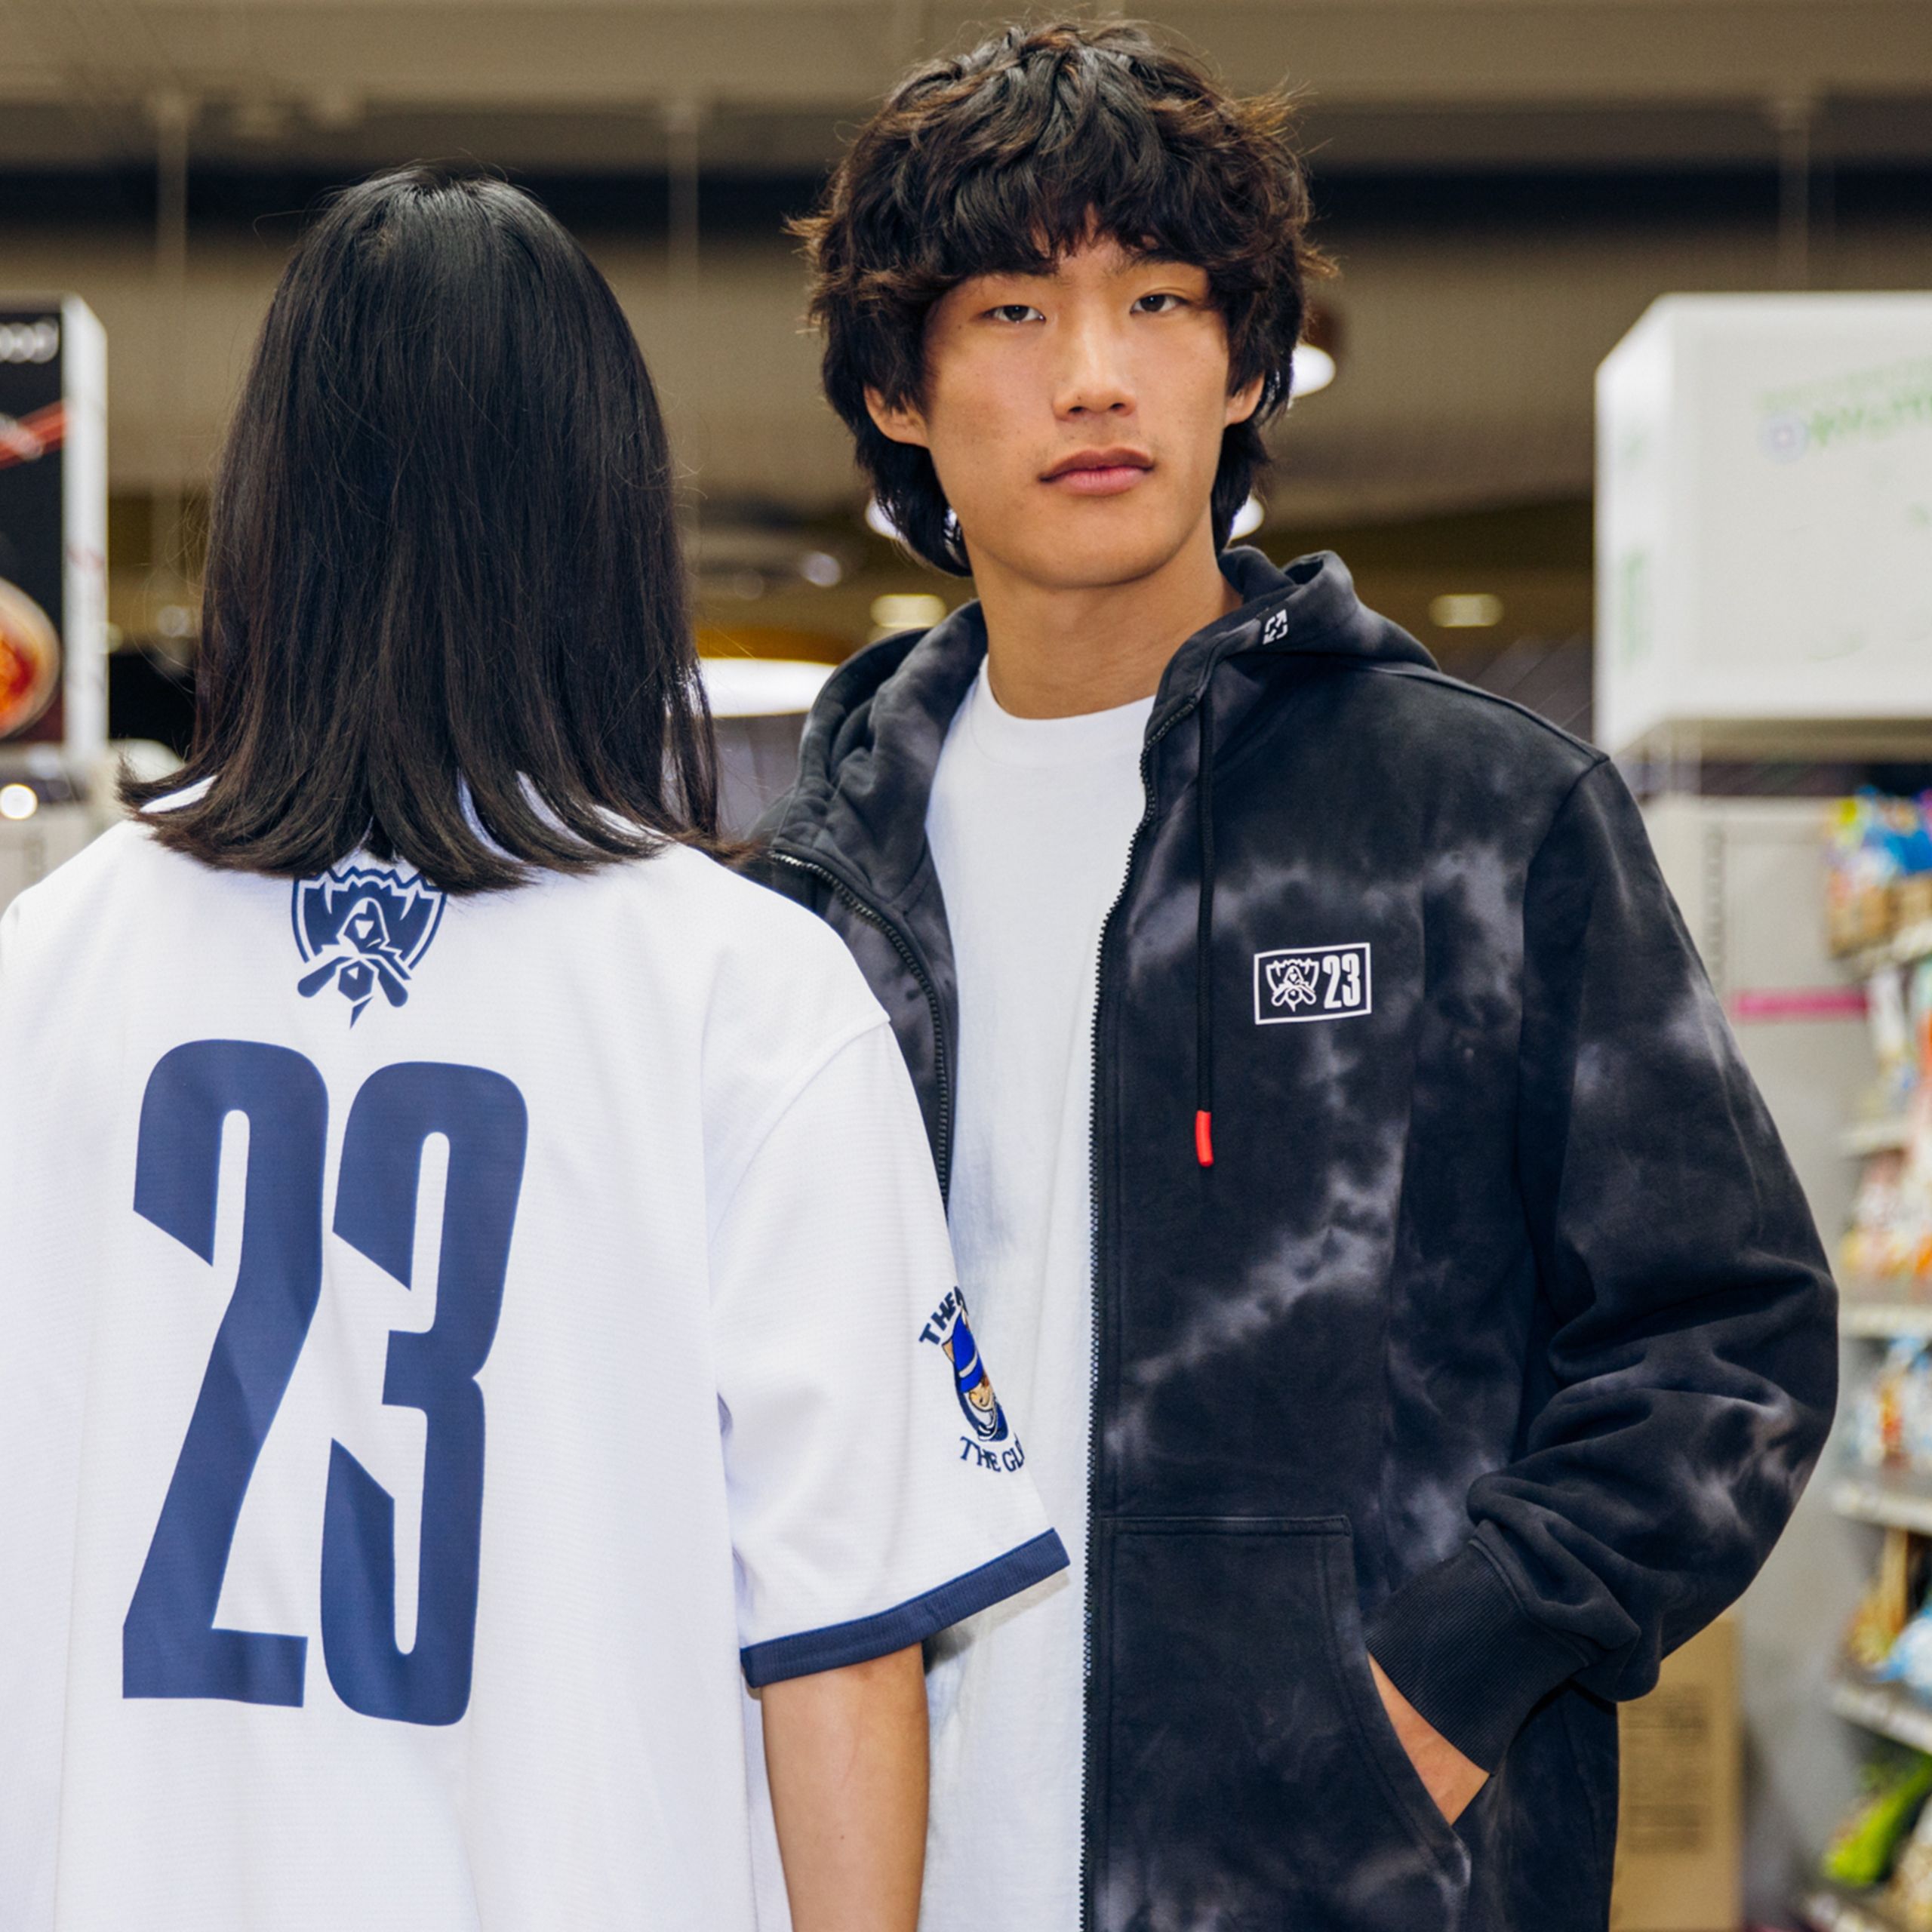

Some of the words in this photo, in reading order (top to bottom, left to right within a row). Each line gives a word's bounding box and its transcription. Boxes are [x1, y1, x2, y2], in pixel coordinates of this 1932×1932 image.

[1322, 952, 1361, 1009] 23
[918, 1291, 956, 1345] THE
[122, 1038, 528, 1727] 23
[960, 1435, 1001, 1472] THE
